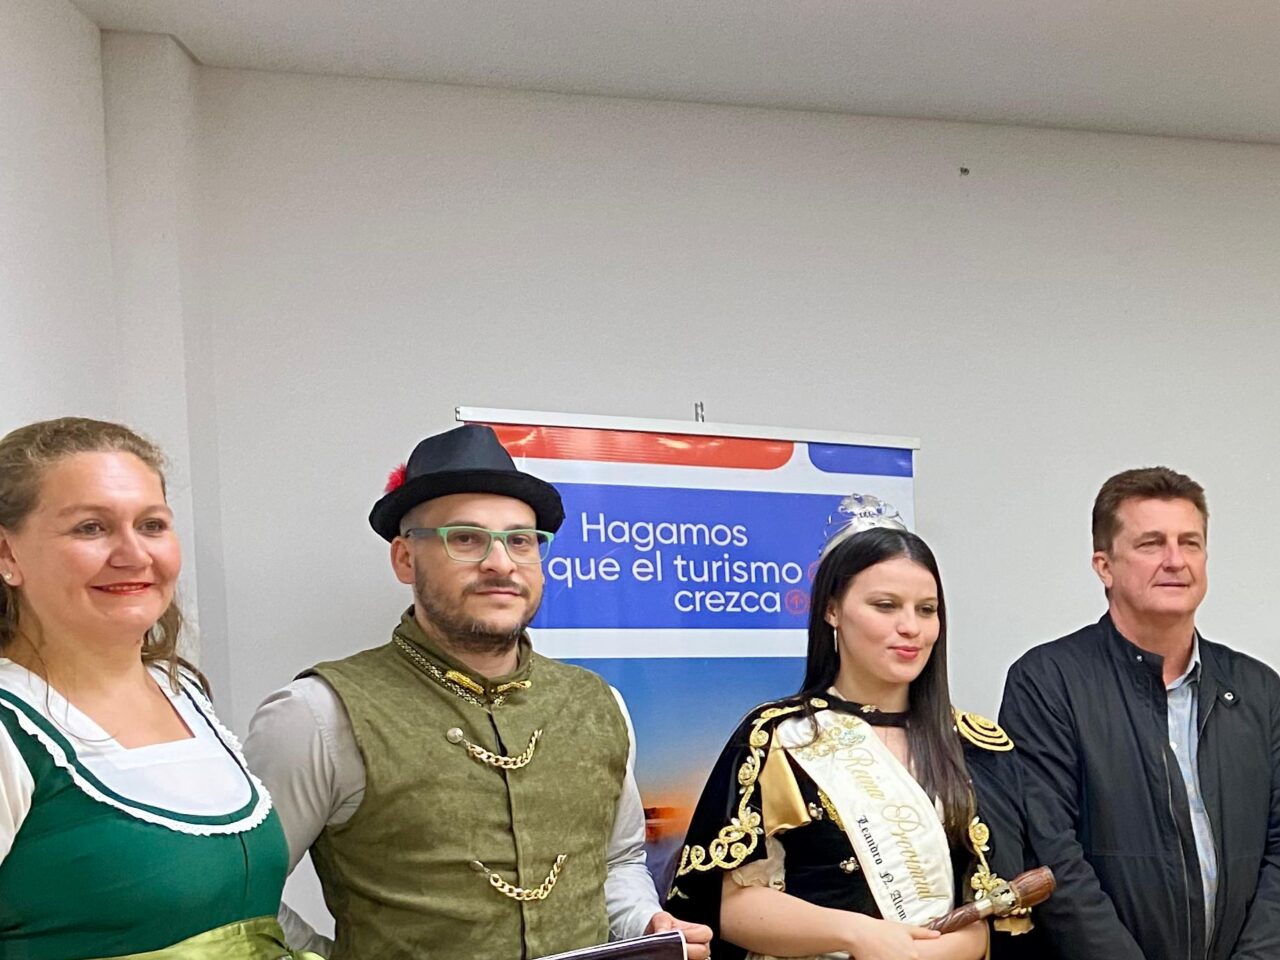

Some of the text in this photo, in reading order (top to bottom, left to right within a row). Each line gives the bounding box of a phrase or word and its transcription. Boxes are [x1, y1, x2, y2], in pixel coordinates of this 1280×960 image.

[581, 512, 748, 552] Hagamos
[547, 551, 803, 588] que el turismo
[674, 587, 782, 613] crezca
[857, 815, 883, 865] Leandro
[889, 889, 907, 921] Alem
